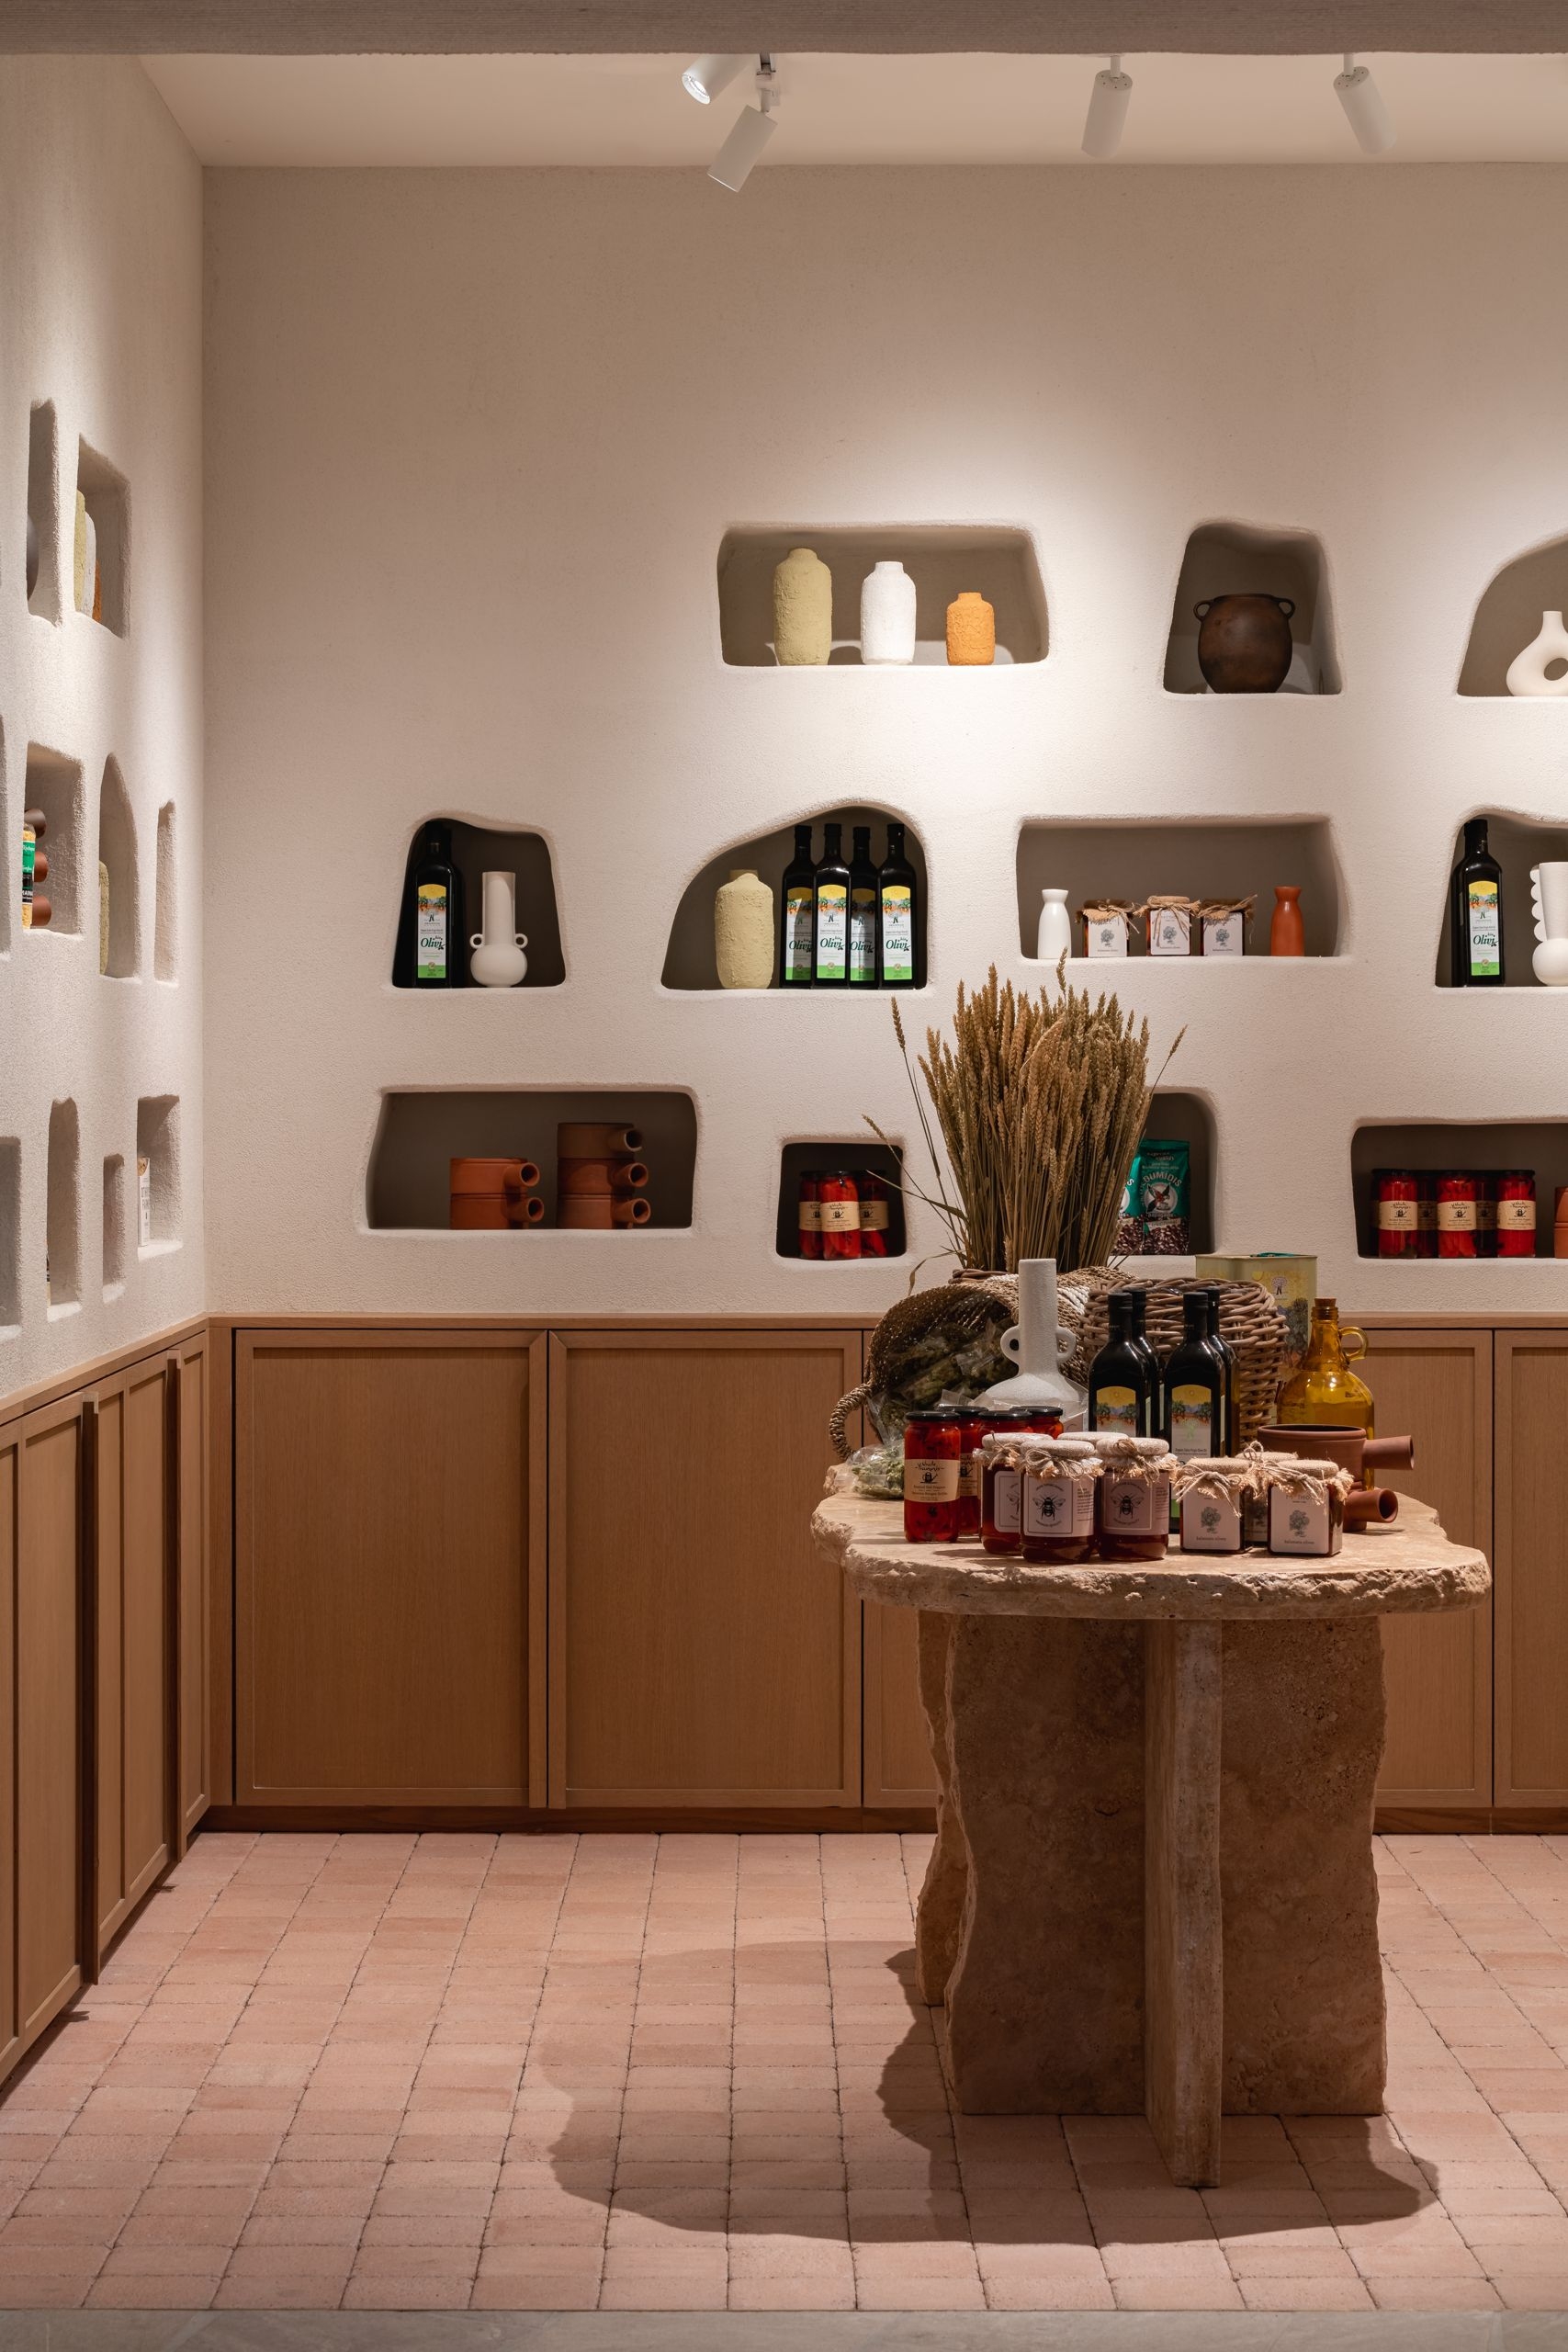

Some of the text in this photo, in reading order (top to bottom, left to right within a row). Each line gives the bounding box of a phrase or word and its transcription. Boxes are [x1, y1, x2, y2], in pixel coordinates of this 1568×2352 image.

[421, 937, 443, 948] Olivi
[820, 937, 842, 949] Olivi
[886, 938, 908, 950] Olivi
[1472, 934, 1495, 945] Olivi
